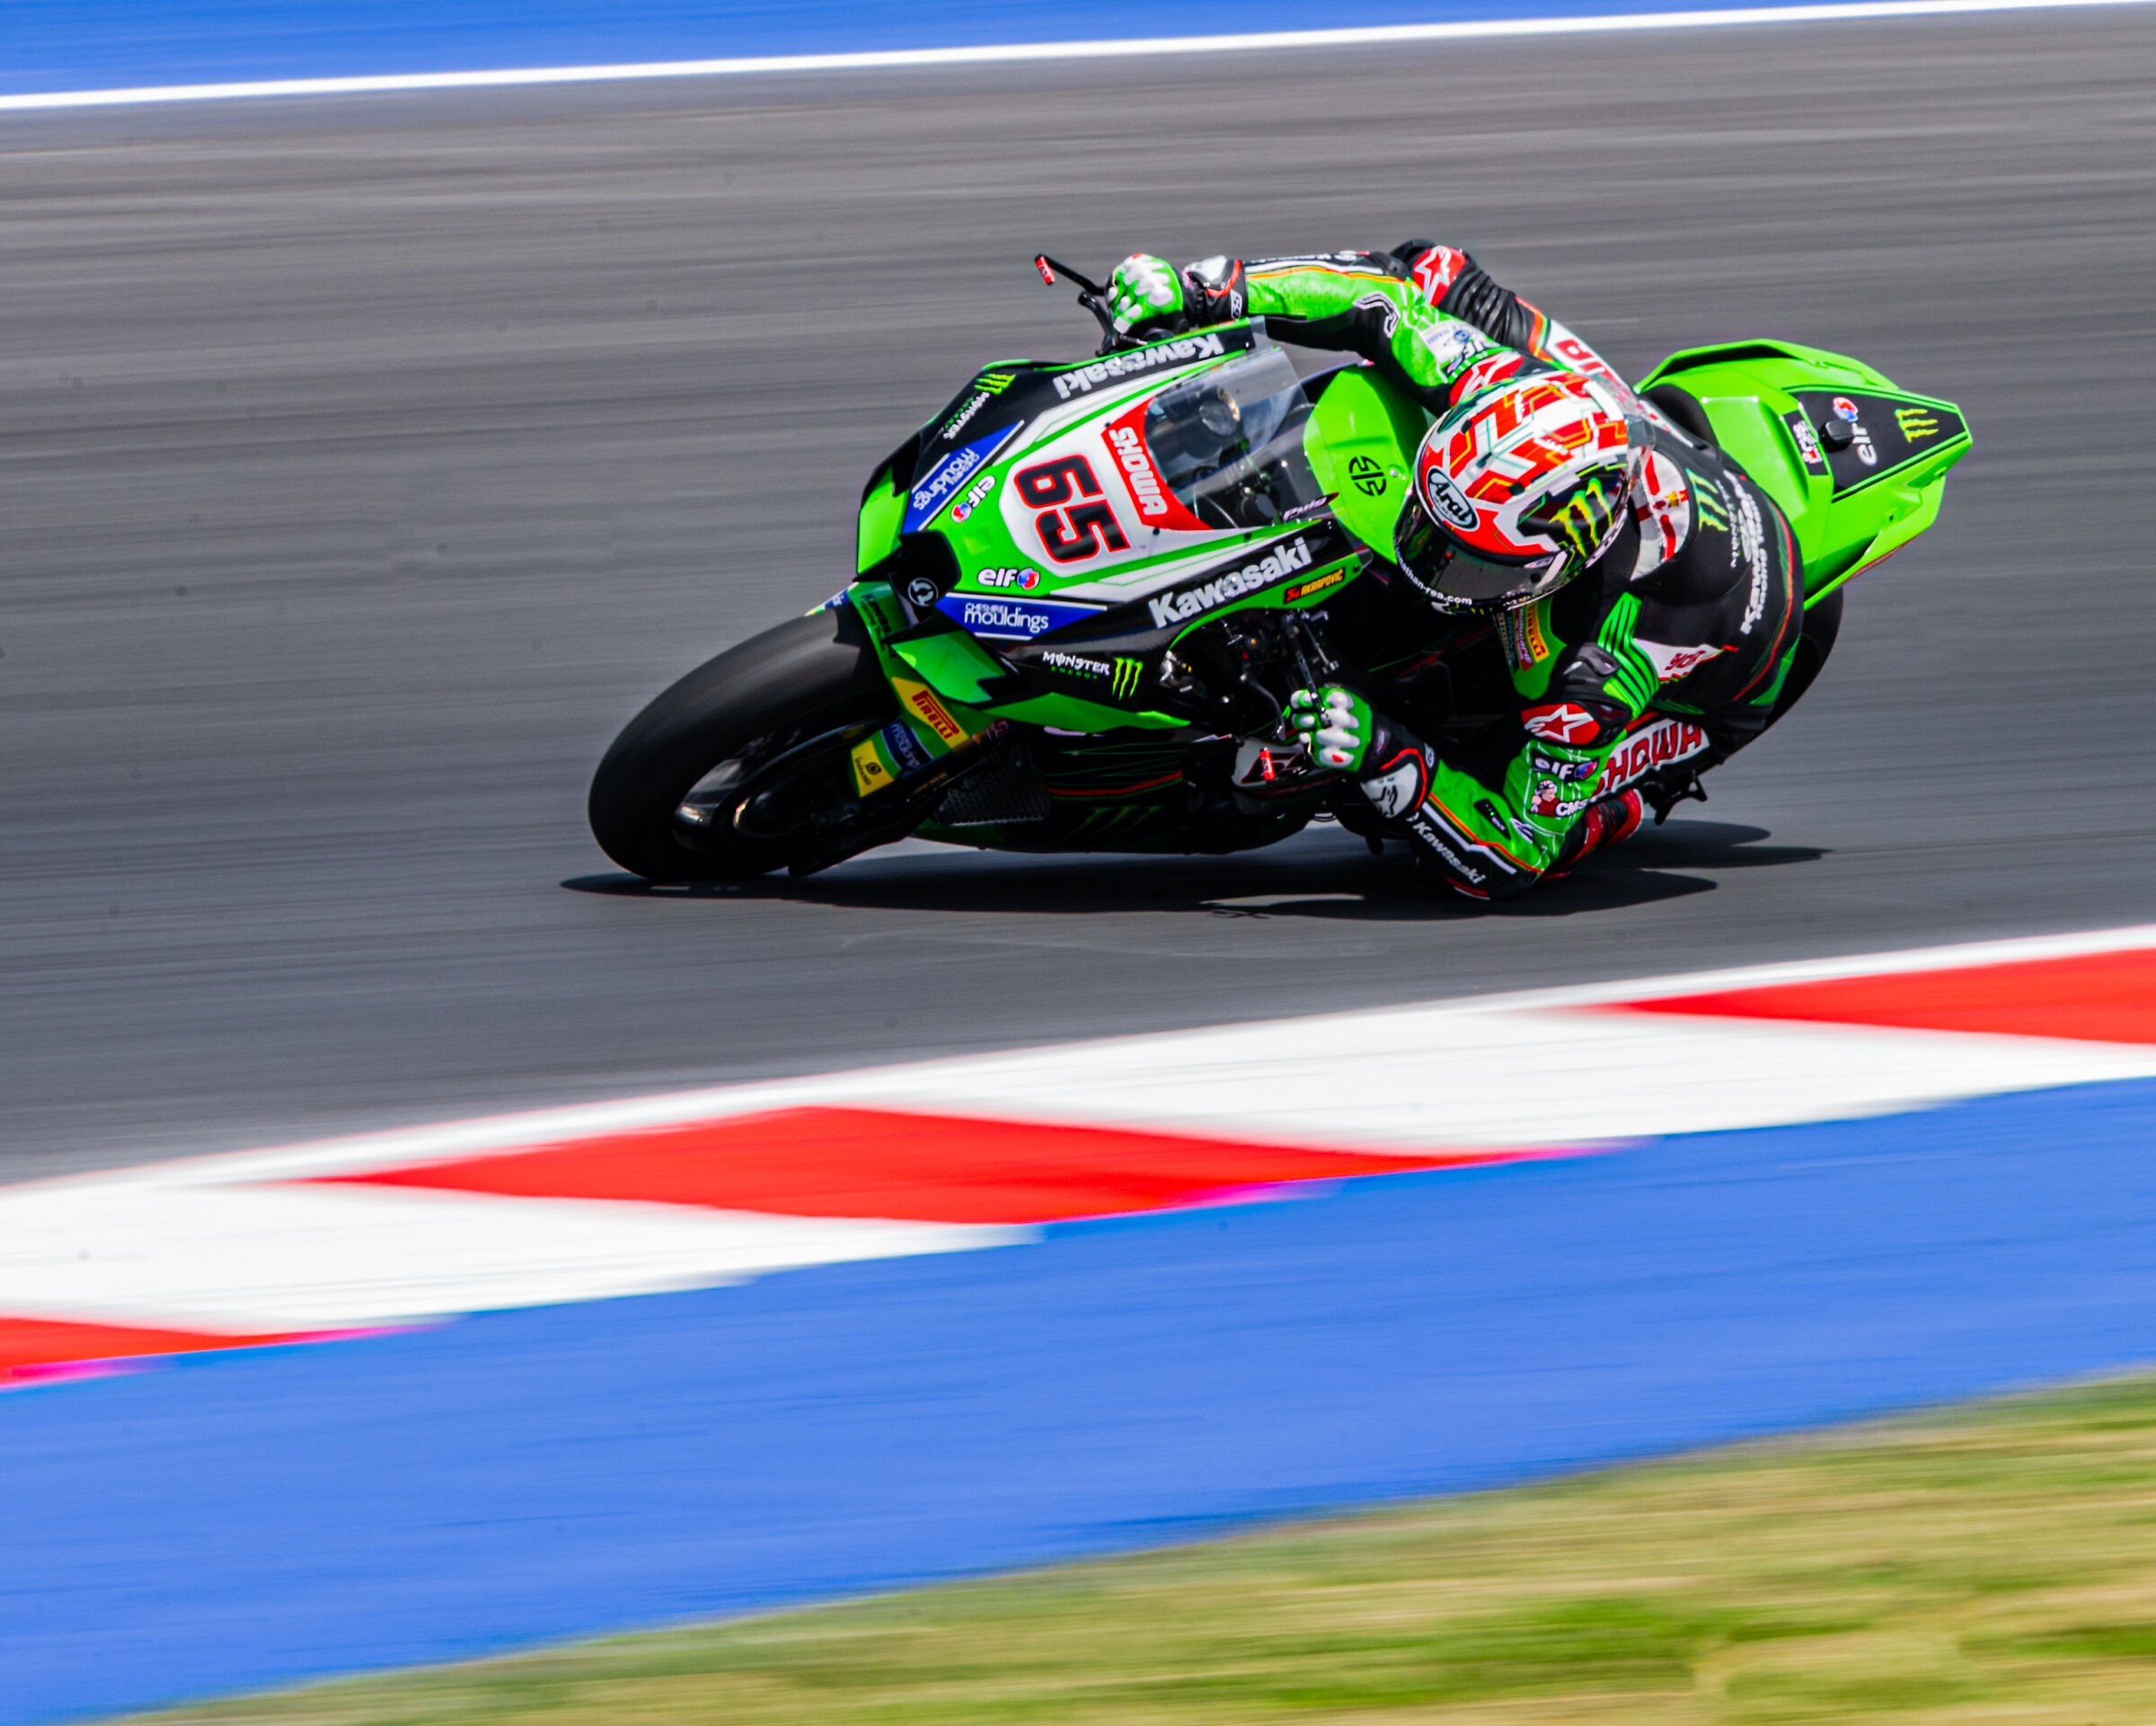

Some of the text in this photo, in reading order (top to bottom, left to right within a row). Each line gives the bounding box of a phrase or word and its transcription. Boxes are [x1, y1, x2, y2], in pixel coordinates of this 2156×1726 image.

[1054, 332, 1224, 399] Kawasaki
[913, 448, 974, 510] mouldings
[971, 474, 997, 514] elf
[1109, 426, 1168, 516] SHOWA
[1012, 453, 1131, 564] 65
[1431, 477, 1471, 521] Arai
[977, 567, 1019, 587] elf
[1147, 536, 1312, 629] Kawasaki
[964, 606, 1049, 633] mouldings
[1042, 651, 1110, 677] MONSTER
[912, 690, 959, 739] PIRELLI
[1412, 819, 1487, 885] Kawasaki
